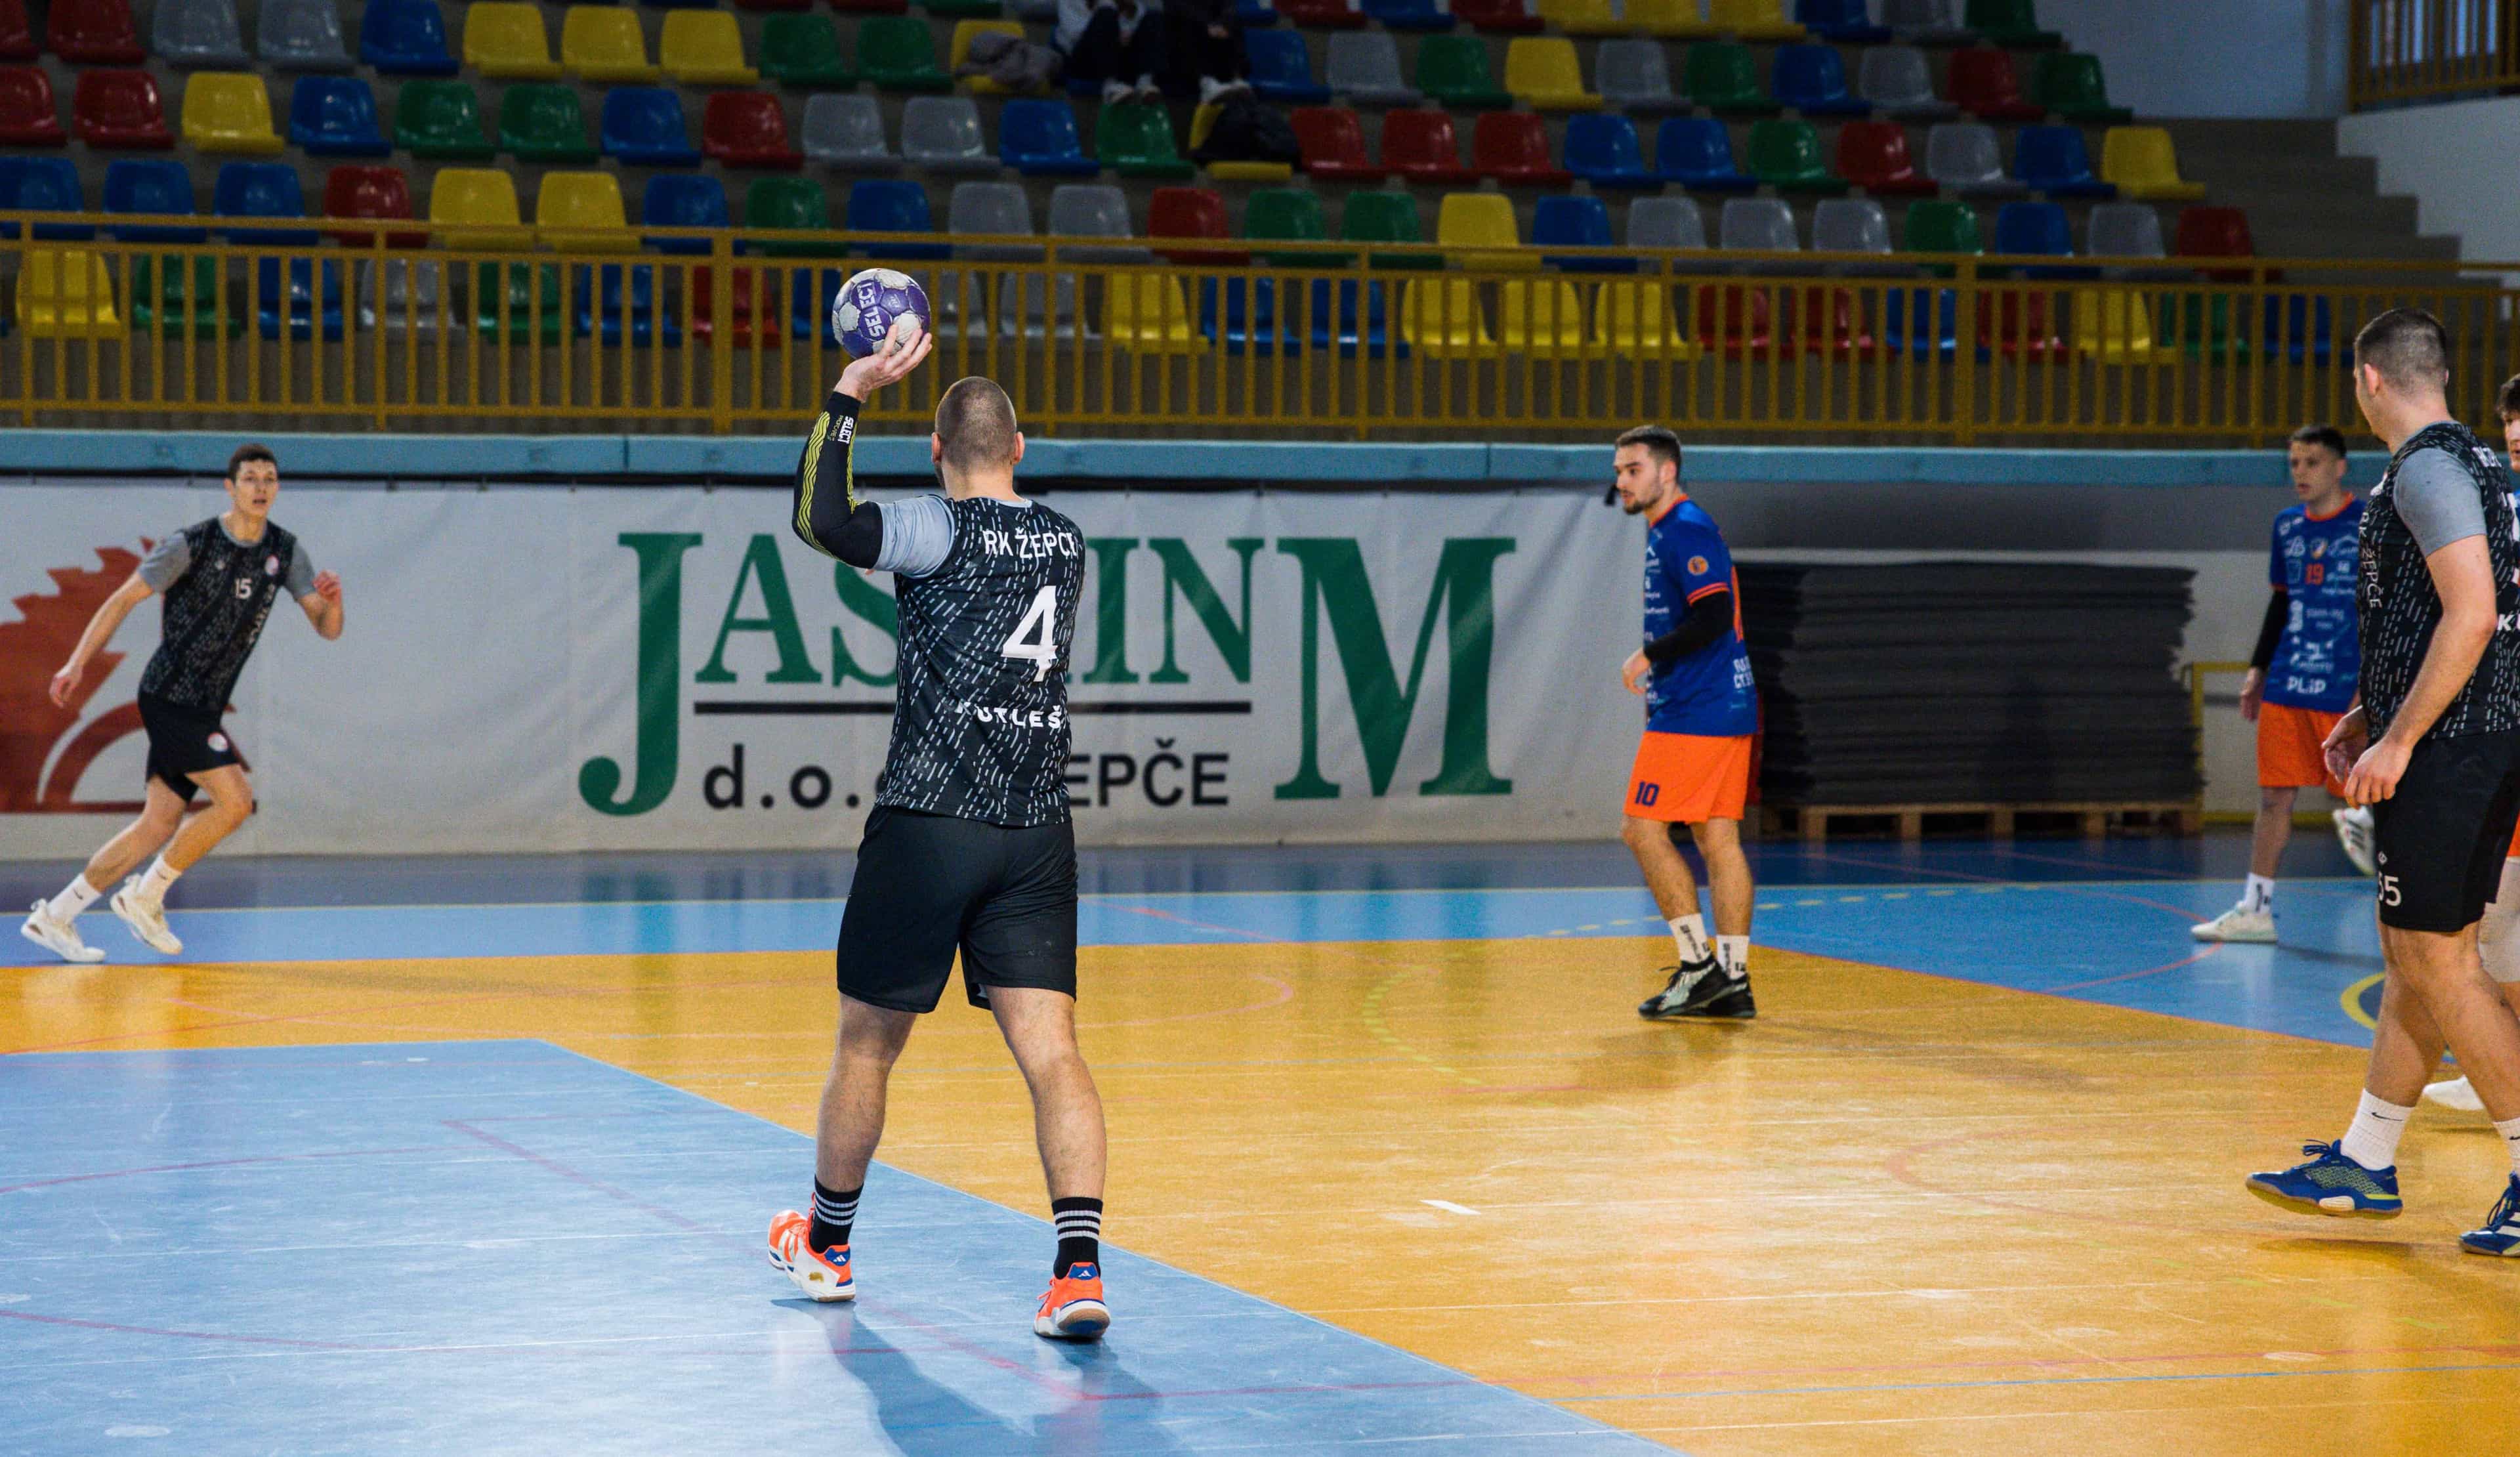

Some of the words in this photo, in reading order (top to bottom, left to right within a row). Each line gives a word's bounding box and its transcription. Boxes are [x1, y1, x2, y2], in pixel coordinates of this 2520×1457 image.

[857, 282, 886, 337] SELECT
[837, 415, 854, 444] SELECT
[982, 528, 1013, 557] RK
[235, 578, 252, 599] 15
[2305, 563, 2324, 585] 19
[1001, 585, 1059, 682] 4
[579, 532, 1517, 816] JASINM
[1064, 738, 1229, 807] EPČE
[1635, 781, 1660, 807] 10
